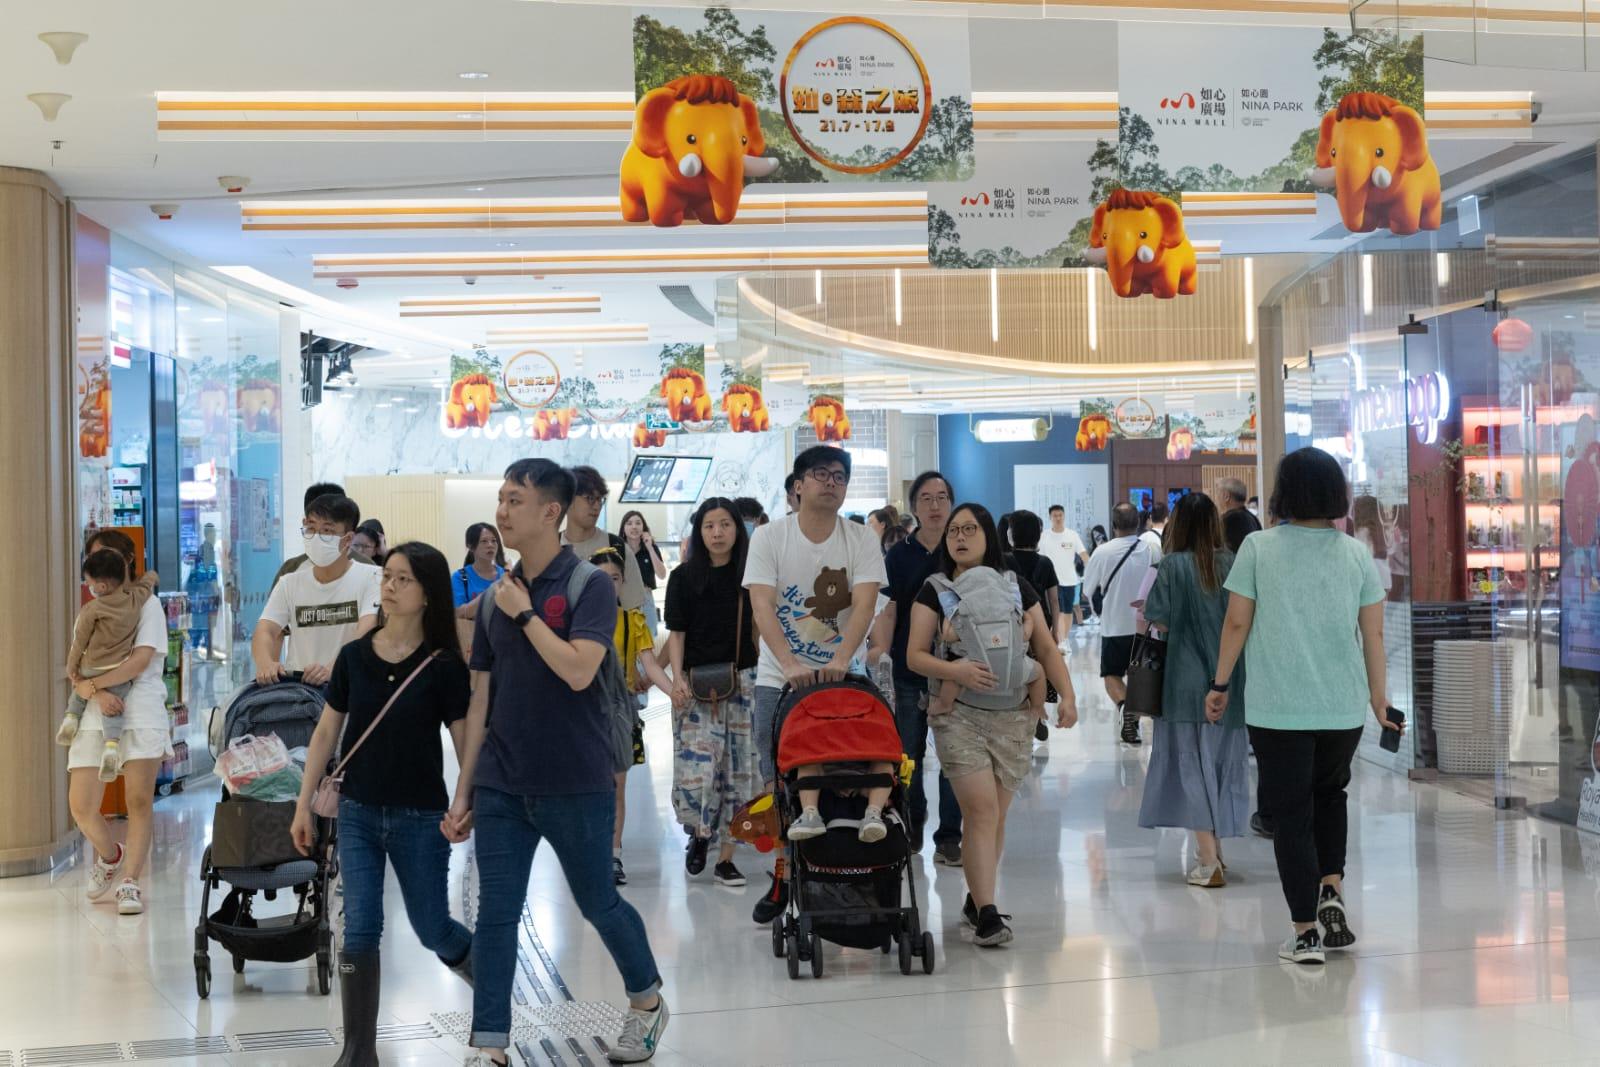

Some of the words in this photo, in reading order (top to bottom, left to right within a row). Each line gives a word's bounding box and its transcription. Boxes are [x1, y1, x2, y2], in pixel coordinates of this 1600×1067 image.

[1200, 87, 1226, 101] 如心
[1241, 101, 1270, 110] NINA
[1273, 102, 1304, 112] PARK
[1195, 118, 1227, 126] MALL
[993, 187, 1015, 198] 如心
[1027, 197, 1051, 205] NINA
[1053, 197, 1080, 206] PARK
[782, 584, 805, 606] It's
[299, 609, 316, 623] JUST
